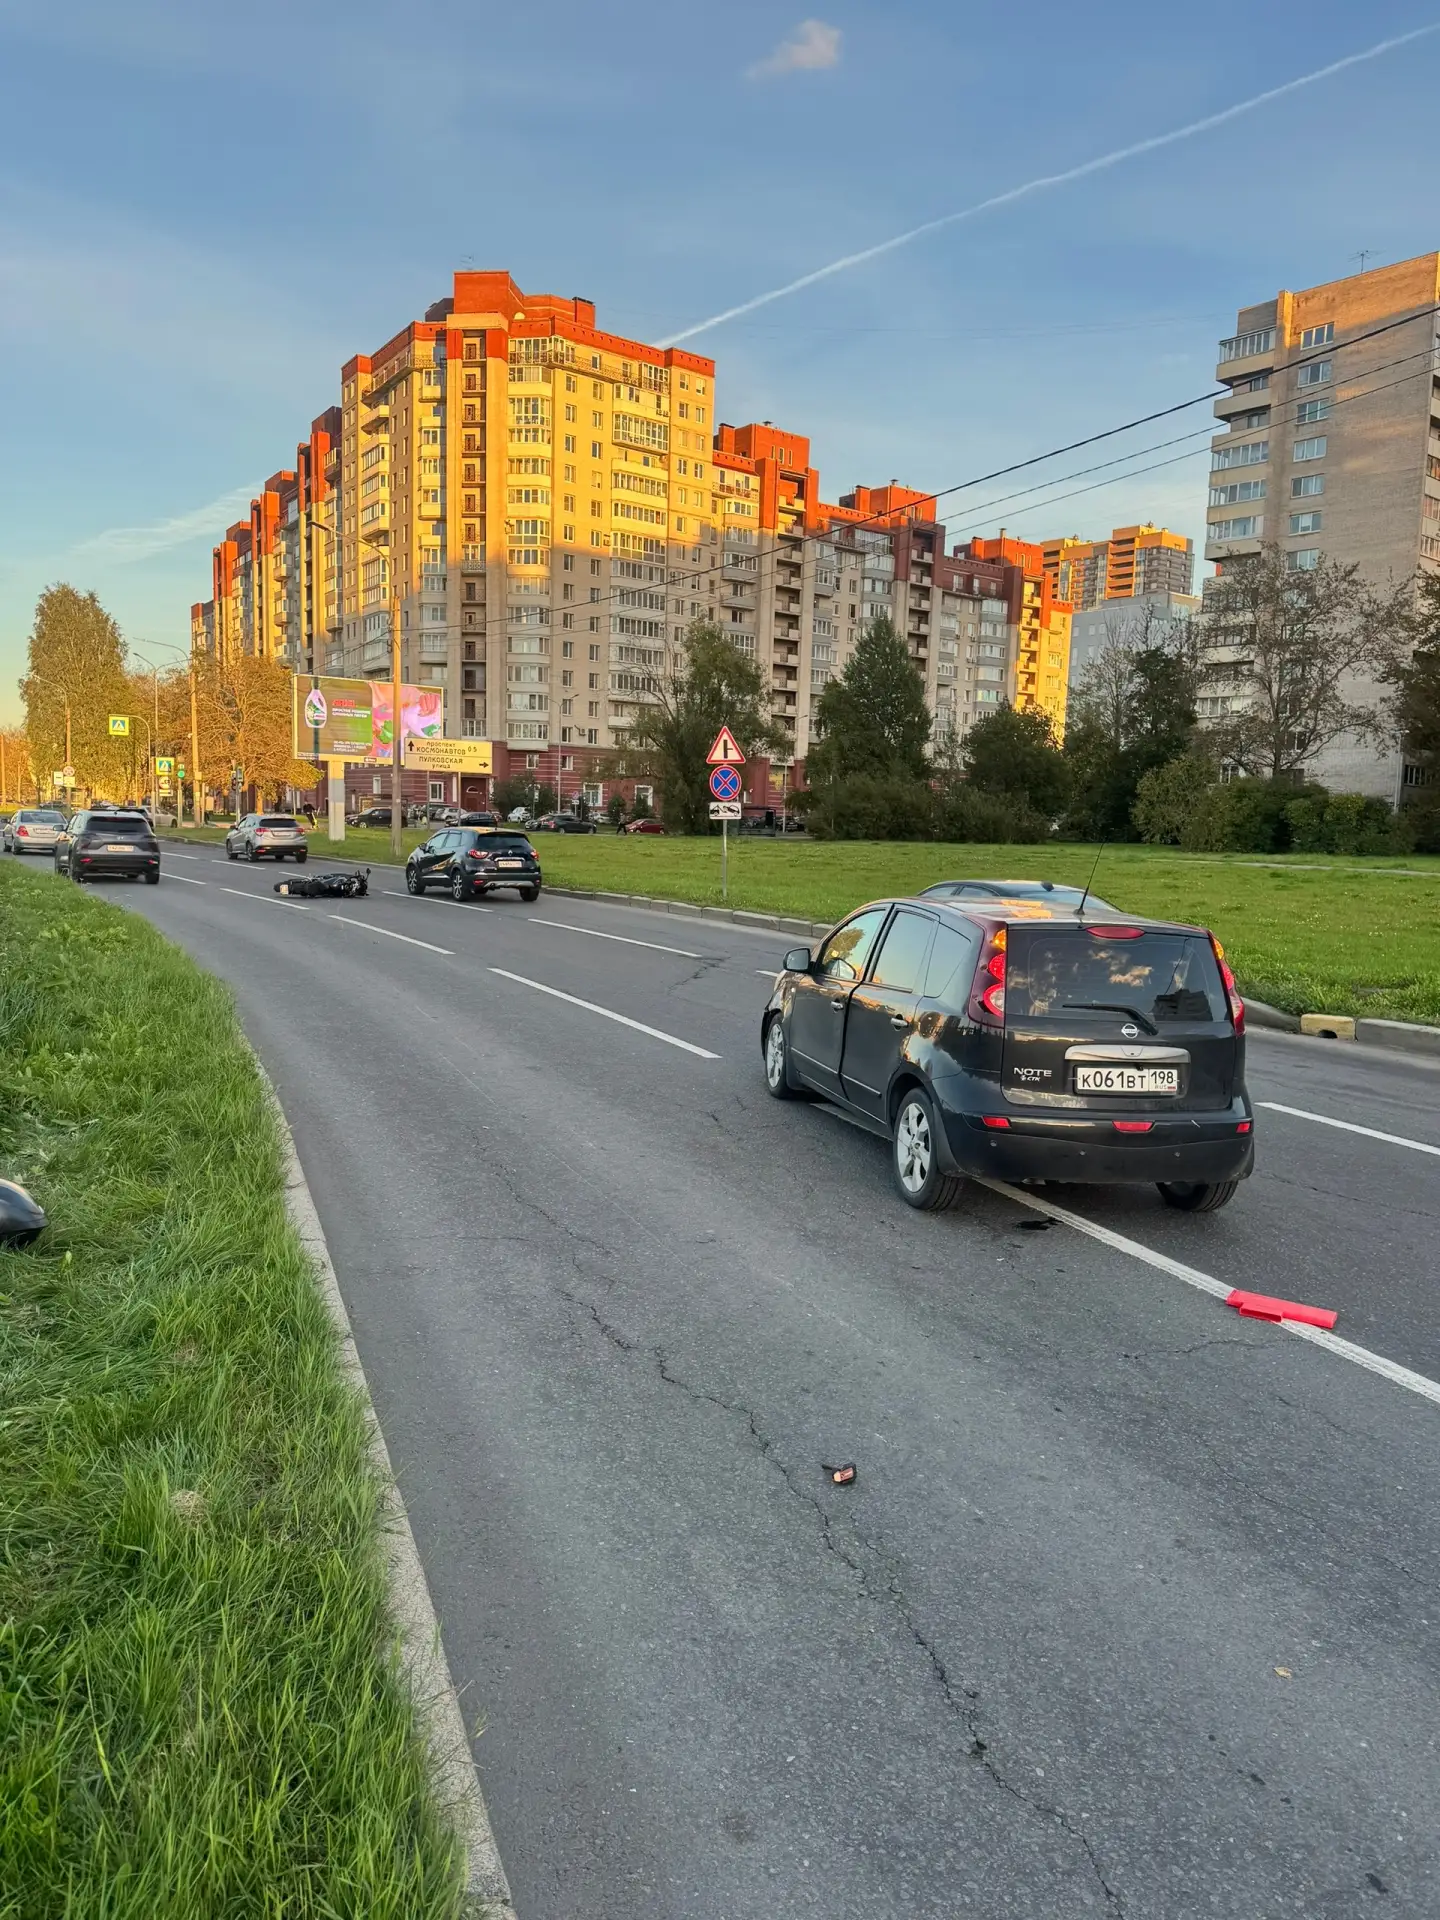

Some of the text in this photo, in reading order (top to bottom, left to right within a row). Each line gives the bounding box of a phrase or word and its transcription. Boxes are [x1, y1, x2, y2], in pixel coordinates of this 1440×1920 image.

[416, 747, 466, 755] КОСМОНАВТОВ
[418, 756, 464, 764] ПУЛКОВСКАЯ
[1013, 1067, 1052, 1077] NOTE
[1150, 1071, 1174, 1084] 198
